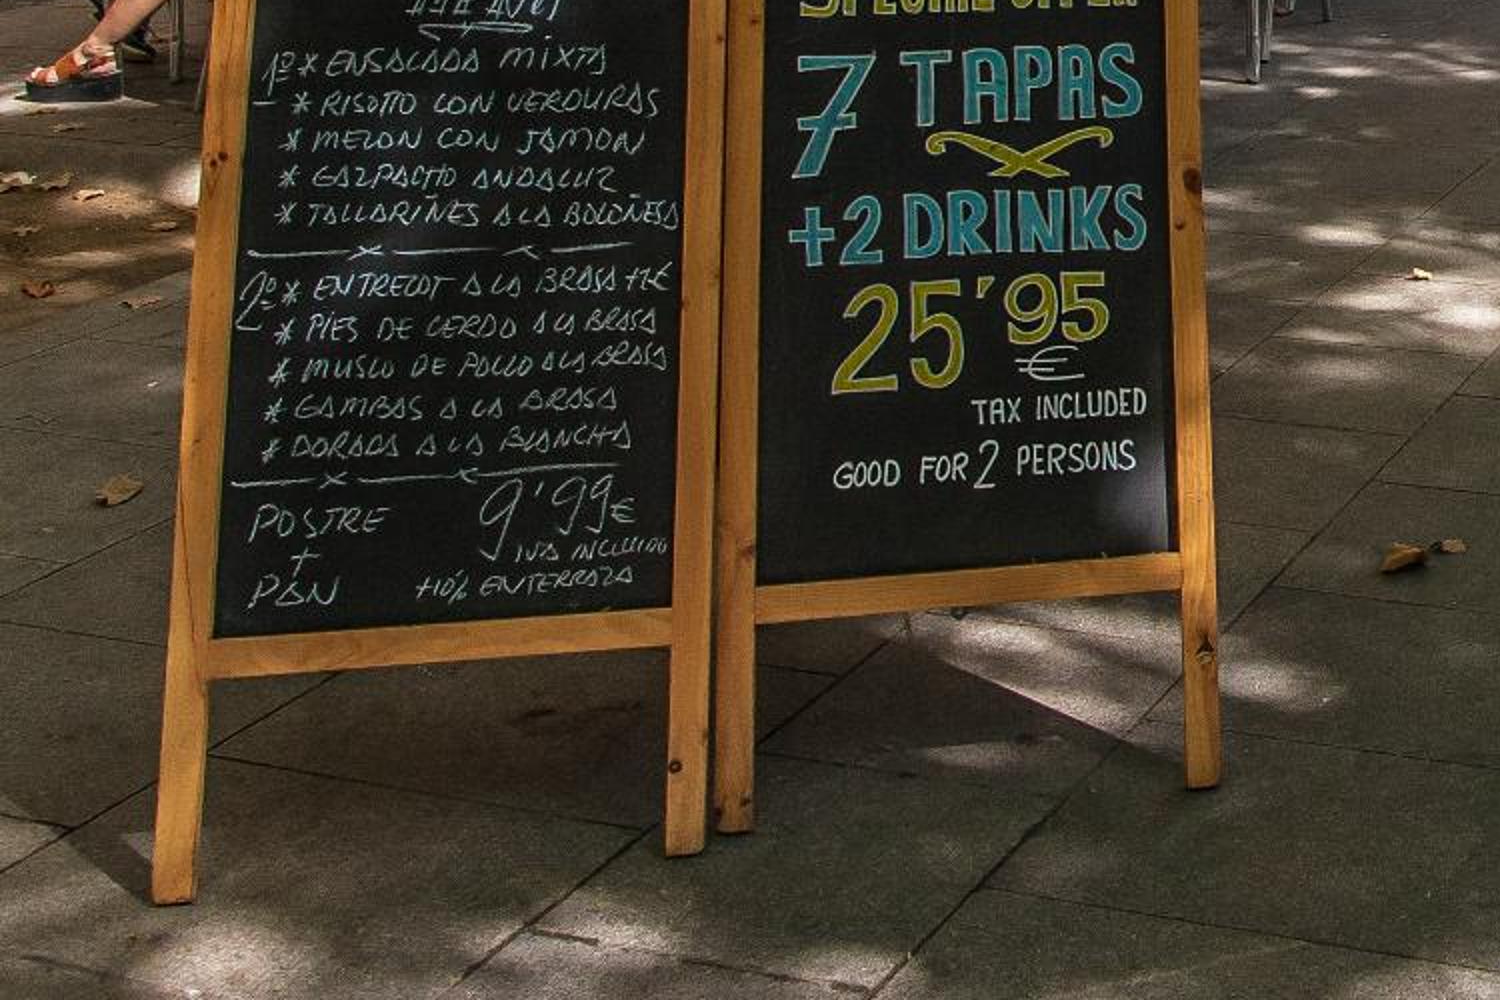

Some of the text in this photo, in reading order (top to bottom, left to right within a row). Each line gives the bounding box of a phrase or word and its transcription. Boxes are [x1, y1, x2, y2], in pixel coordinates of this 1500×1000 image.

[324, 47, 480, 78] ENSALADA
[433, 91, 495, 115] CON
[507, 82, 659, 117] VERDURAS
[791, 42, 1144, 179] 7 TAPAS
[311, 126, 645, 156] MELON CON JAMON
[902, 183, 1148, 259] DRINKS
[376, 316, 413, 341] DE
[426, 313, 517, 339] CERDO
[831, 271, 1110, 396] 25'95
[410, 353, 447, 378] DE
[457, 351, 533, 378] POLLO
[1014, 344, 1086, 381] €
[293, 393, 423, 421] GAMBAS
[969, 387, 1147, 426] TAX INCLUDED
[832, 439, 1138, 489] GOOD FOR 2 PERSONS
[248, 503, 390, 543] POSTRE
[247, 571, 339, 609] PAN
